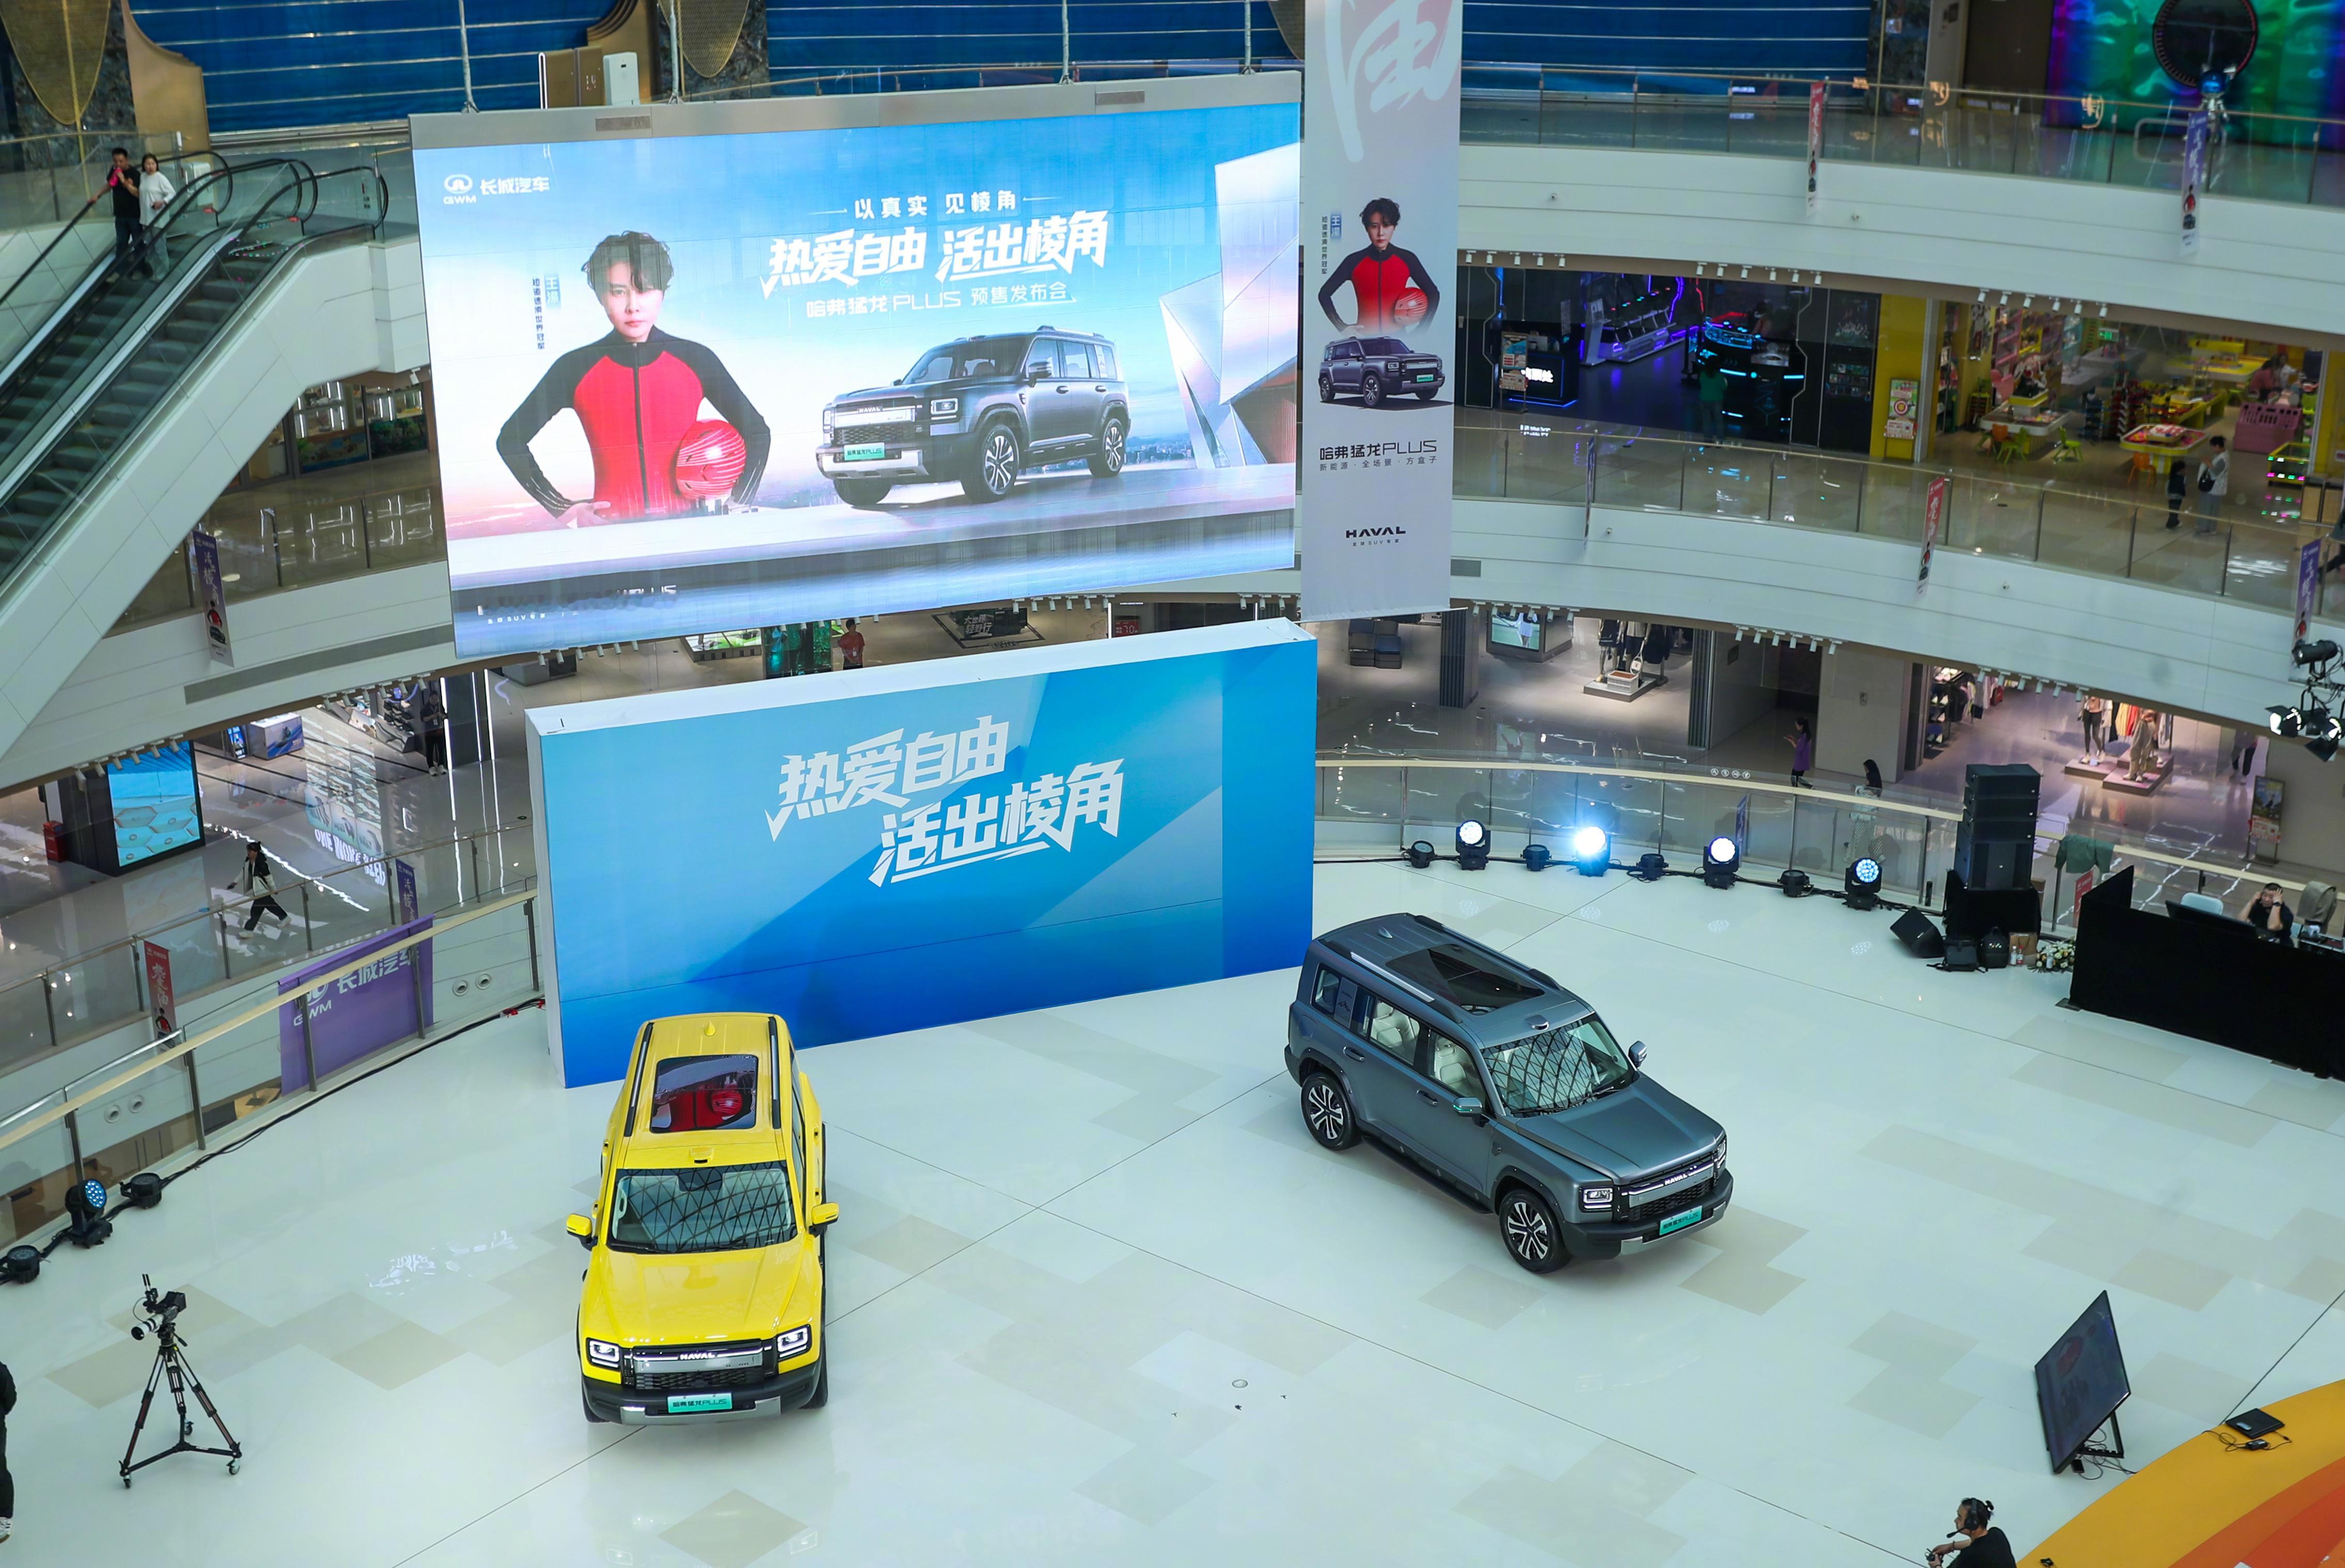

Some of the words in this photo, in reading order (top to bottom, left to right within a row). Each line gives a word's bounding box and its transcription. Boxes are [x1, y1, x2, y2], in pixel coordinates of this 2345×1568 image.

[480, 176, 550, 195] 长城汽车
[443, 195, 477, 205] GWM
[855, 196, 928, 219] 以真实
[946, 190, 1016, 215] 见棱角
[760, 227, 927, 299] 热爱自由
[935, 209, 1108, 284] 活出棱角
[806, 291, 961, 318] 哈弗猛龙PLUS
[971, 282, 1067, 304] 预售发布会
[1319, 440, 1437, 460] 哈弗猛龙PLUS
[1346, 526, 1406, 539] HAVAL
[765, 715, 1010, 842] 热爱自由
[868, 758, 1124, 887] 活出棱角
[1665, 1174, 1687, 1185] HAVAL
[680, 1352, 715, 1360] HAVAL
[673, 1399, 727, 1407] 哈弗猛龙PLUS
